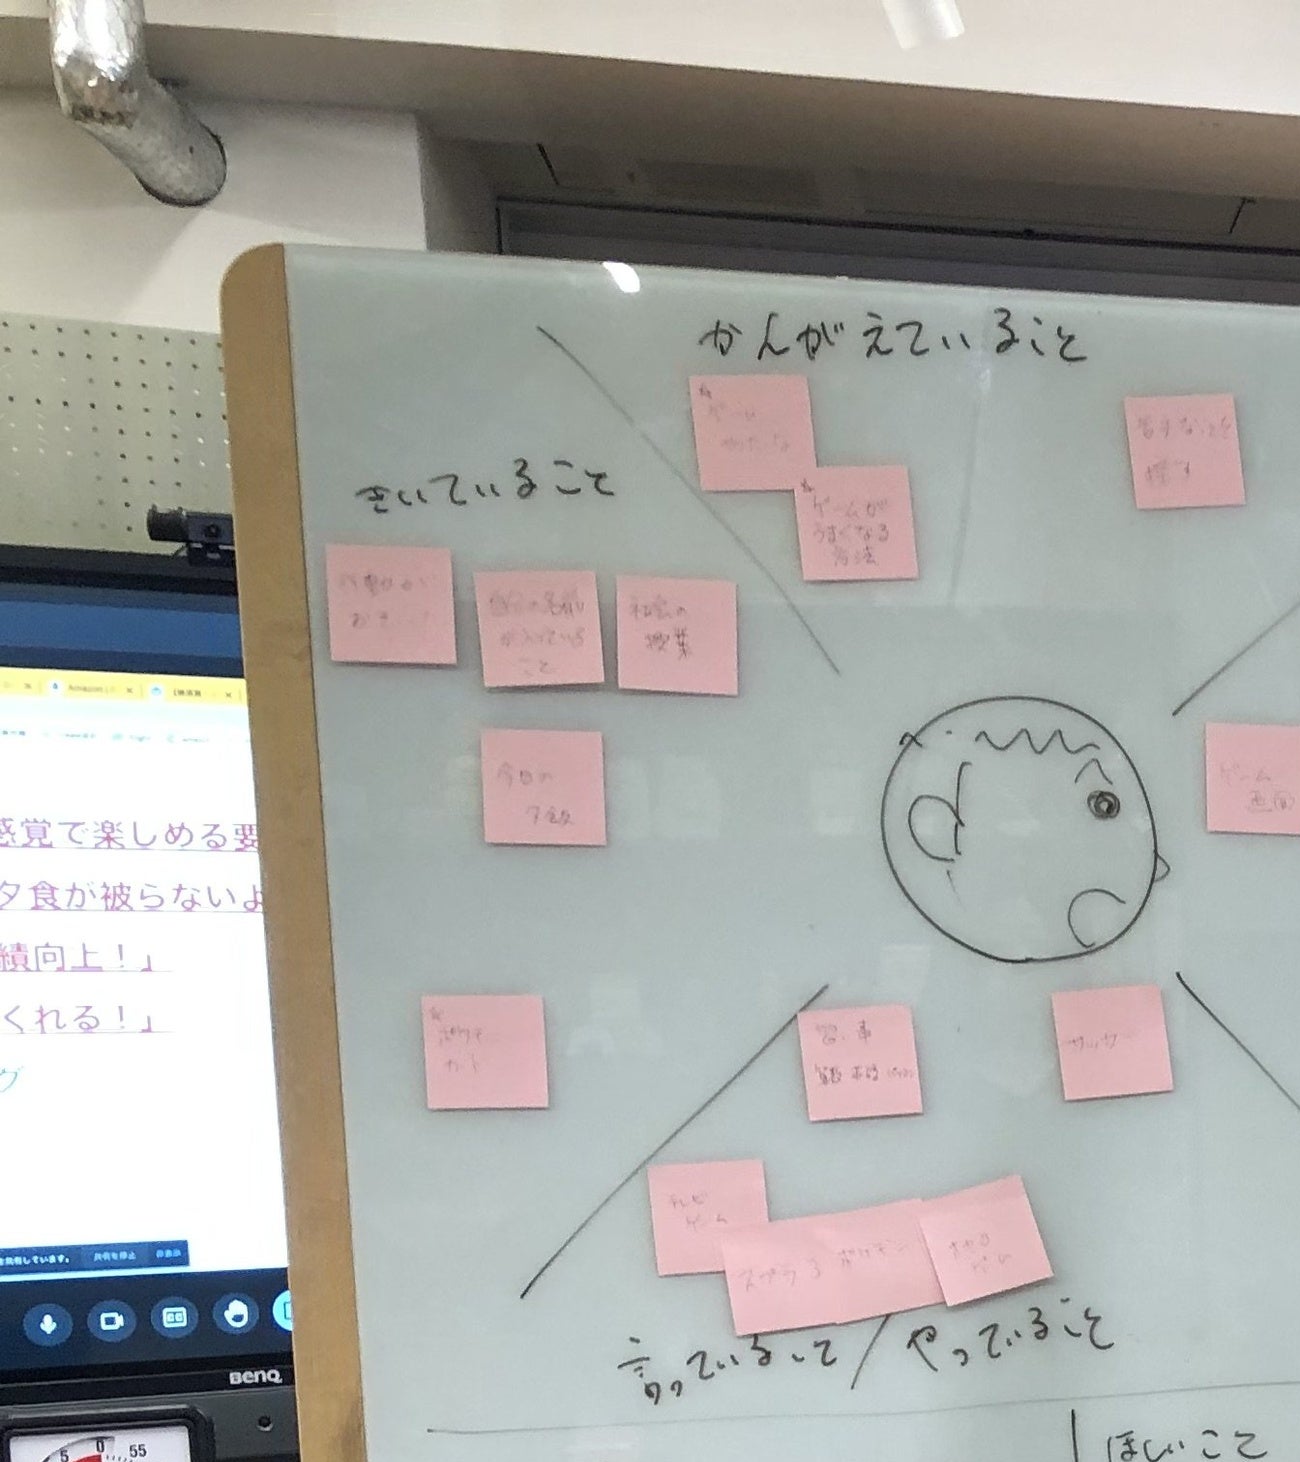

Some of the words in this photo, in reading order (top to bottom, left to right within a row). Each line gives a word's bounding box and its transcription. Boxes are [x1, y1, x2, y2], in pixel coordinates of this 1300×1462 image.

[699, 306, 1088, 361] かんがえていること
[355, 458, 614, 515] きいていること
[229, 1368, 283, 1385] BenQ
[96, 1440, 105, 1454] 0
[129, 1444, 147, 1458] 55
